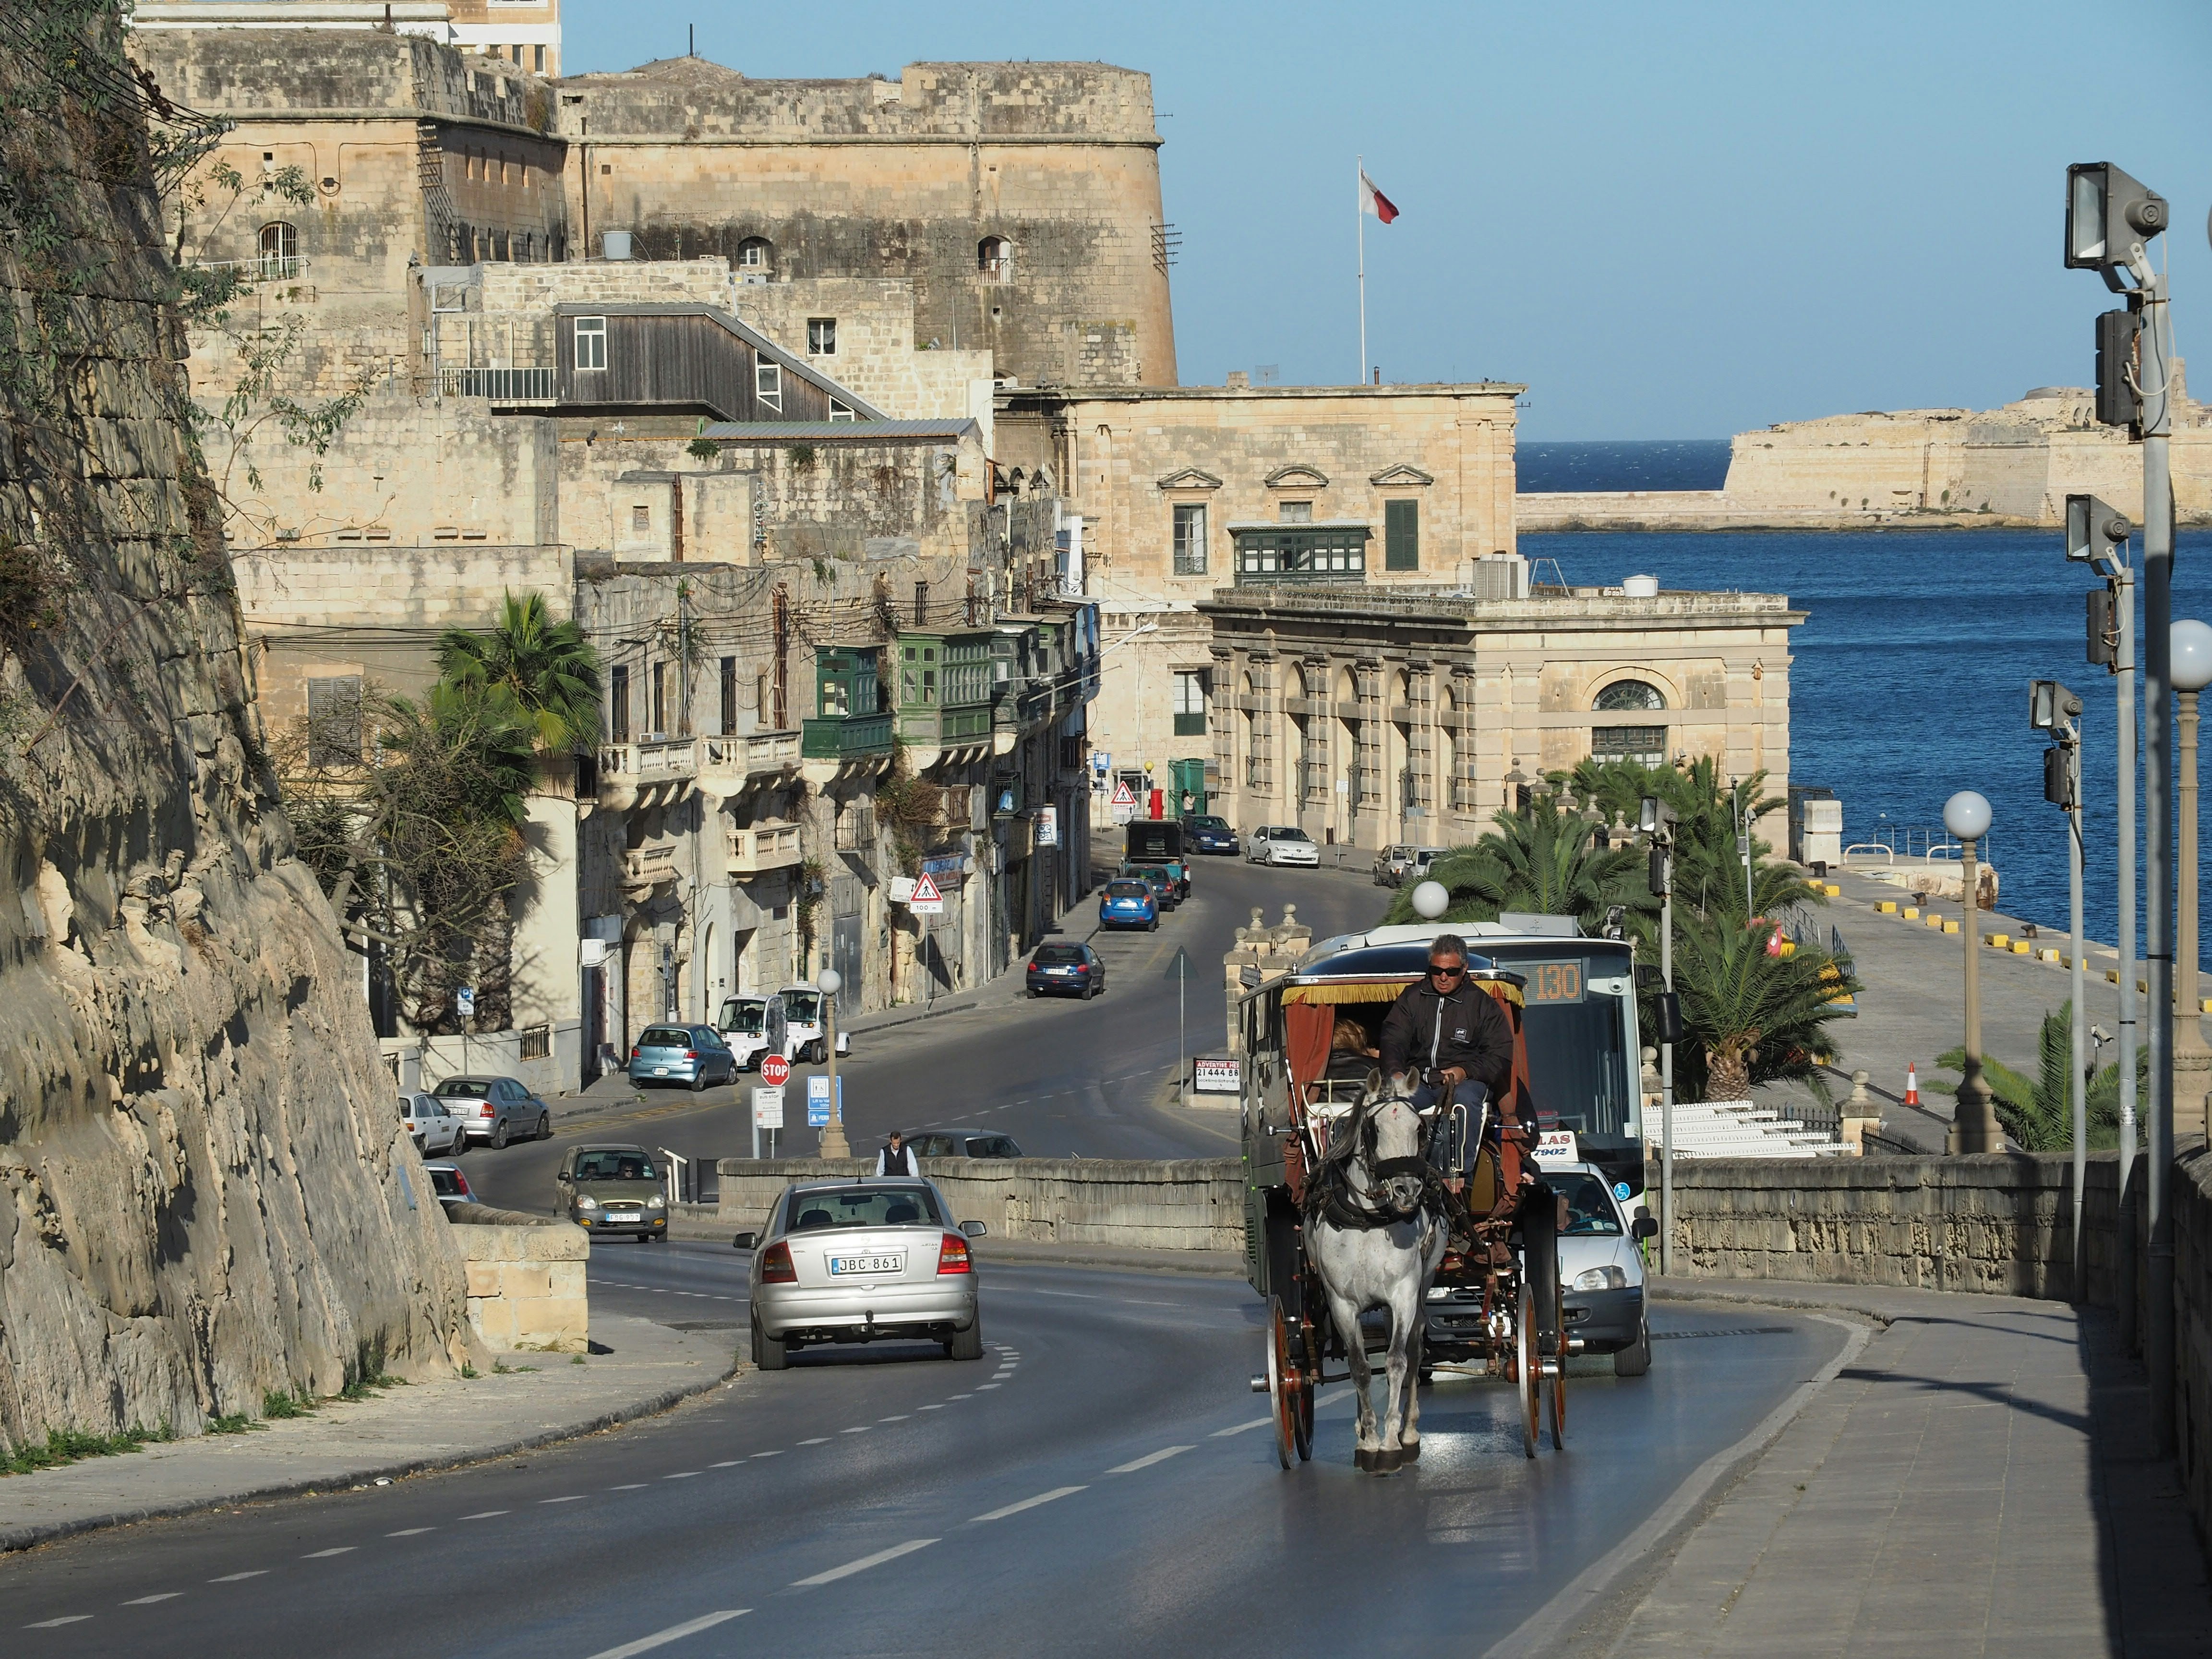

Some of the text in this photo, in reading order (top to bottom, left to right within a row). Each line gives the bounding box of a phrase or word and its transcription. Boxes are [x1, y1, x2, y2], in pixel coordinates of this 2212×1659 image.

[1037, 825, 1051, 833] ce
[1037, 832, 1052, 841] ea
[1537, 964, 1579, 999] 130
[763, 1064, 788, 1077] STOP
[1538, 1134, 1571, 1145] LAS
[840, 1257, 899, 1271] JBC 861
